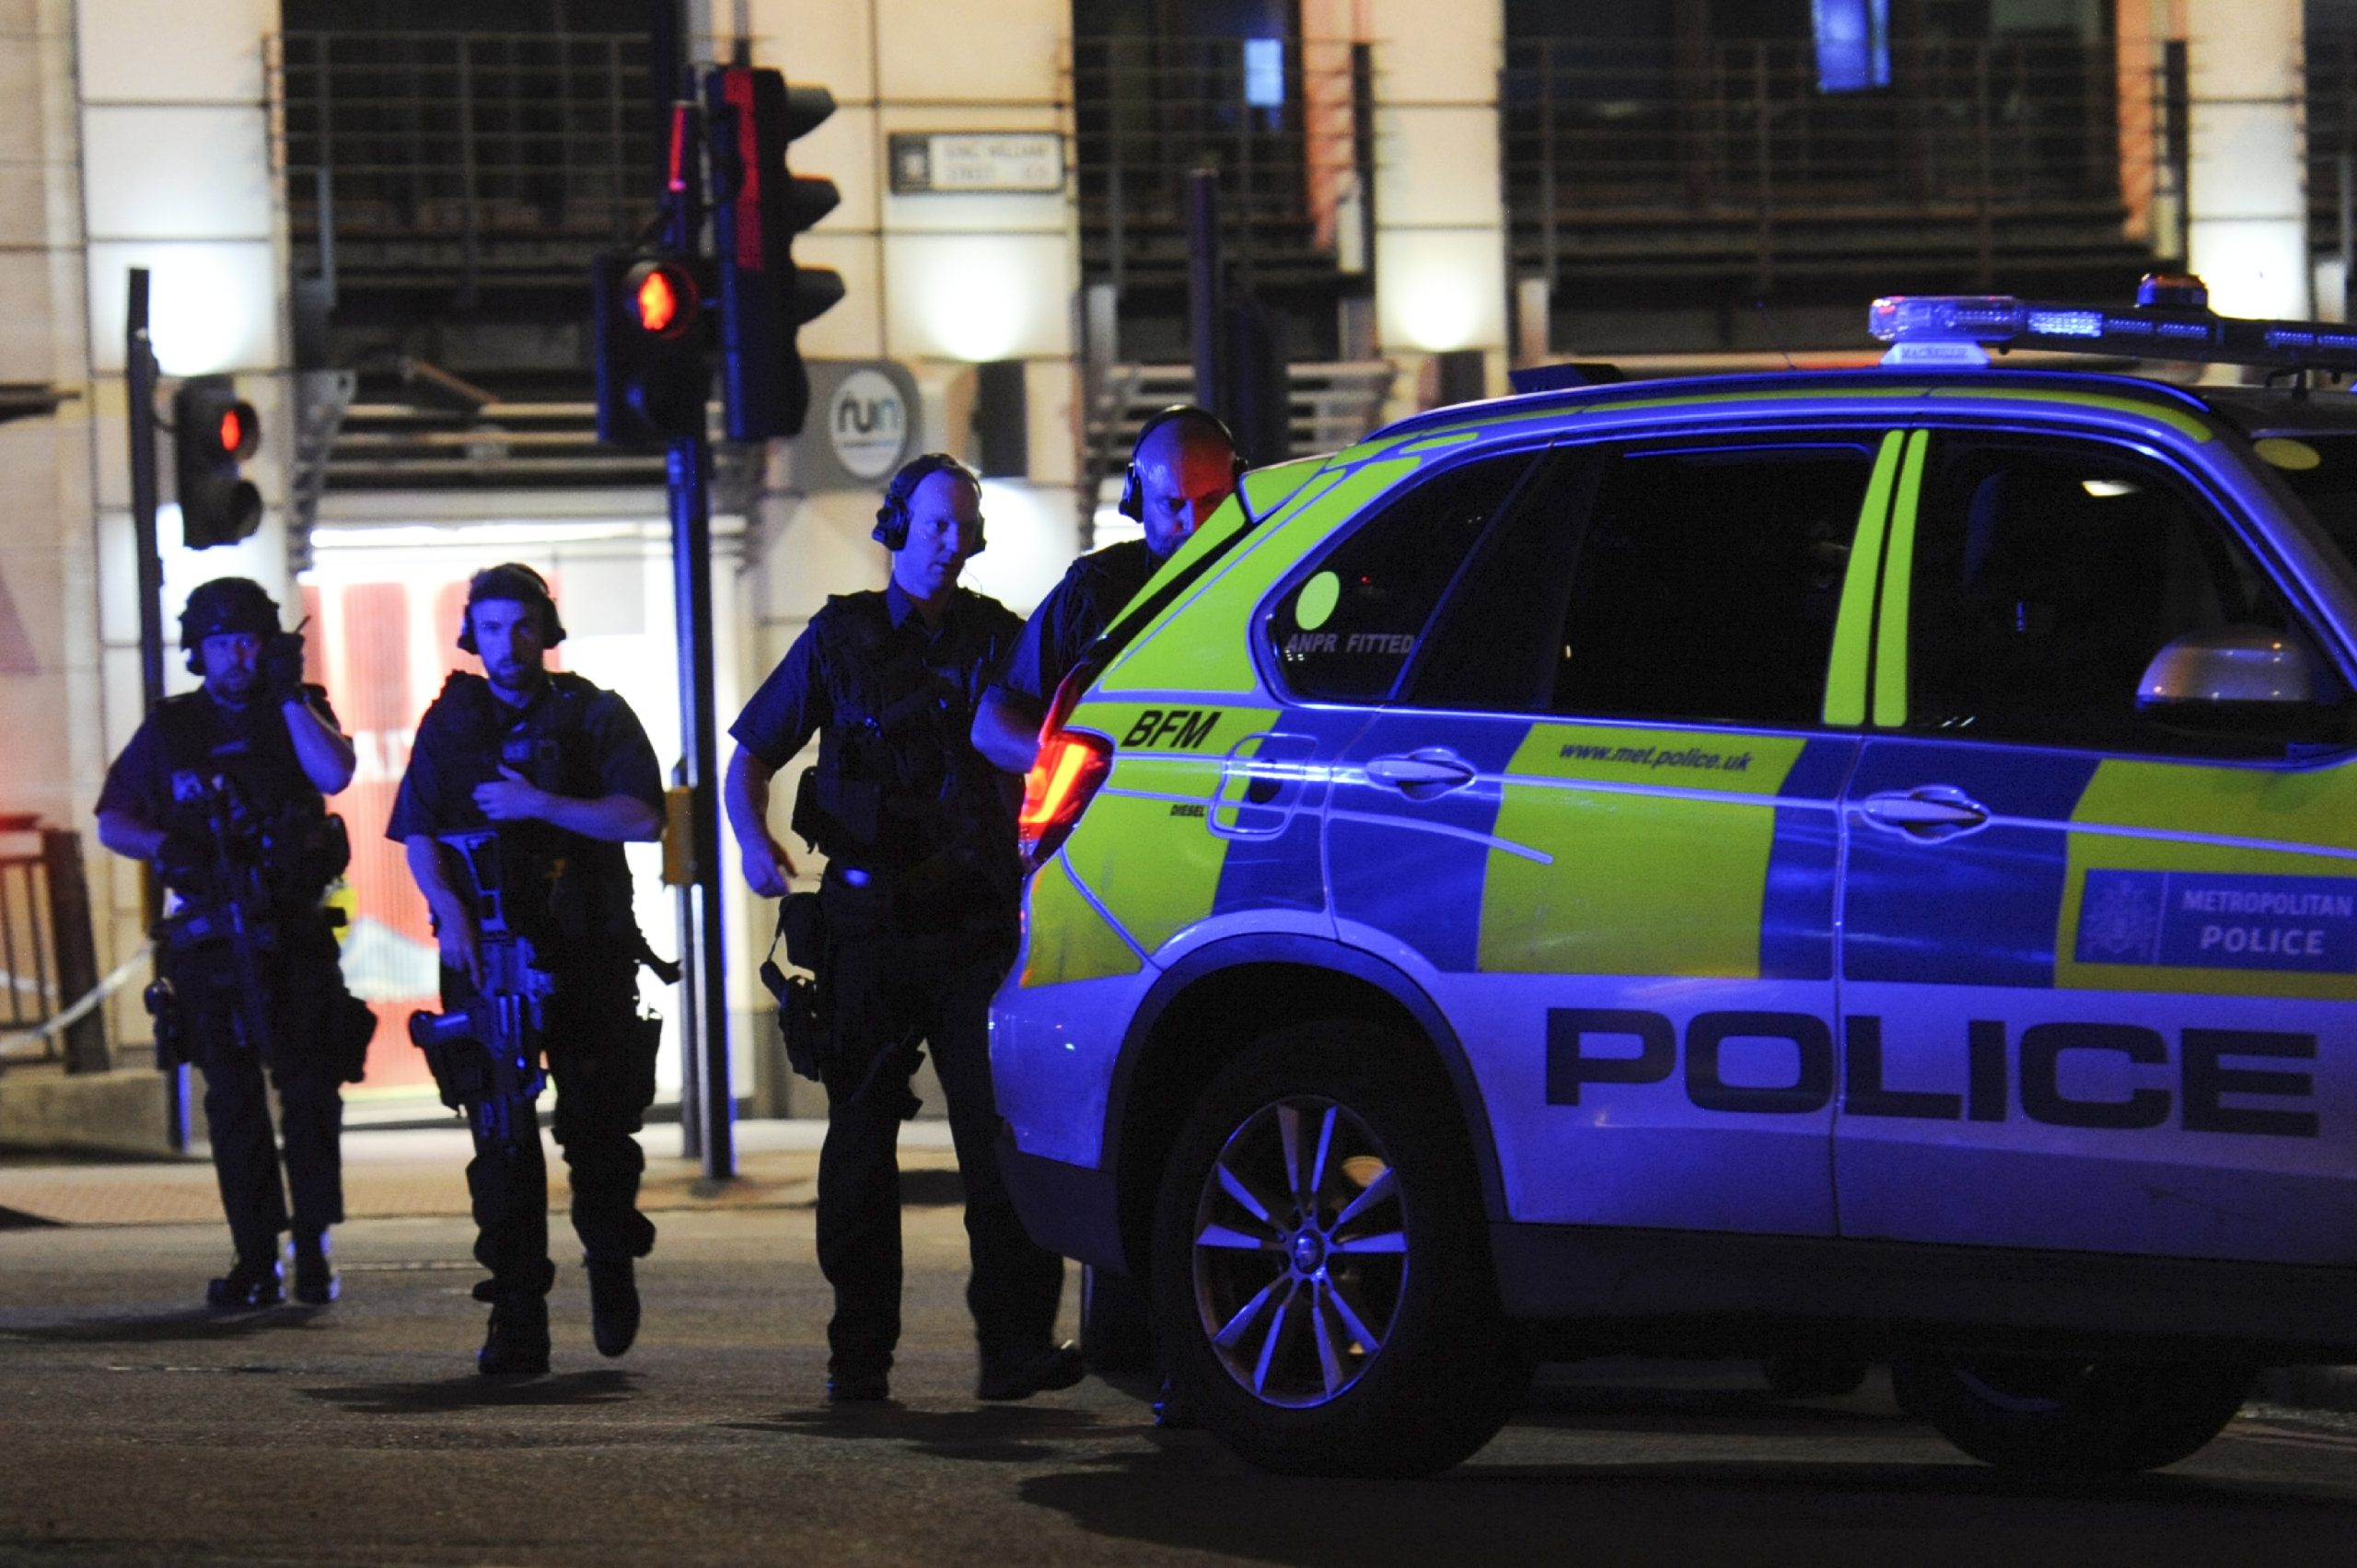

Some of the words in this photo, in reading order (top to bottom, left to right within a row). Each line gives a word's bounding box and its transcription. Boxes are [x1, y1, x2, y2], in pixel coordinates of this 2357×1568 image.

[1285, 633, 1338, 652] ANPR
[1346, 633, 1416, 654] FITTED
[1120, 710, 1223, 749] BFM
[1560, 744, 1753, 772] www.met.police.uk
[2181, 889, 2354, 917] METROPOLITAN
[2200, 924, 2326, 956] POLICE
[1544, 1006, 2320, 1138] POLICE
